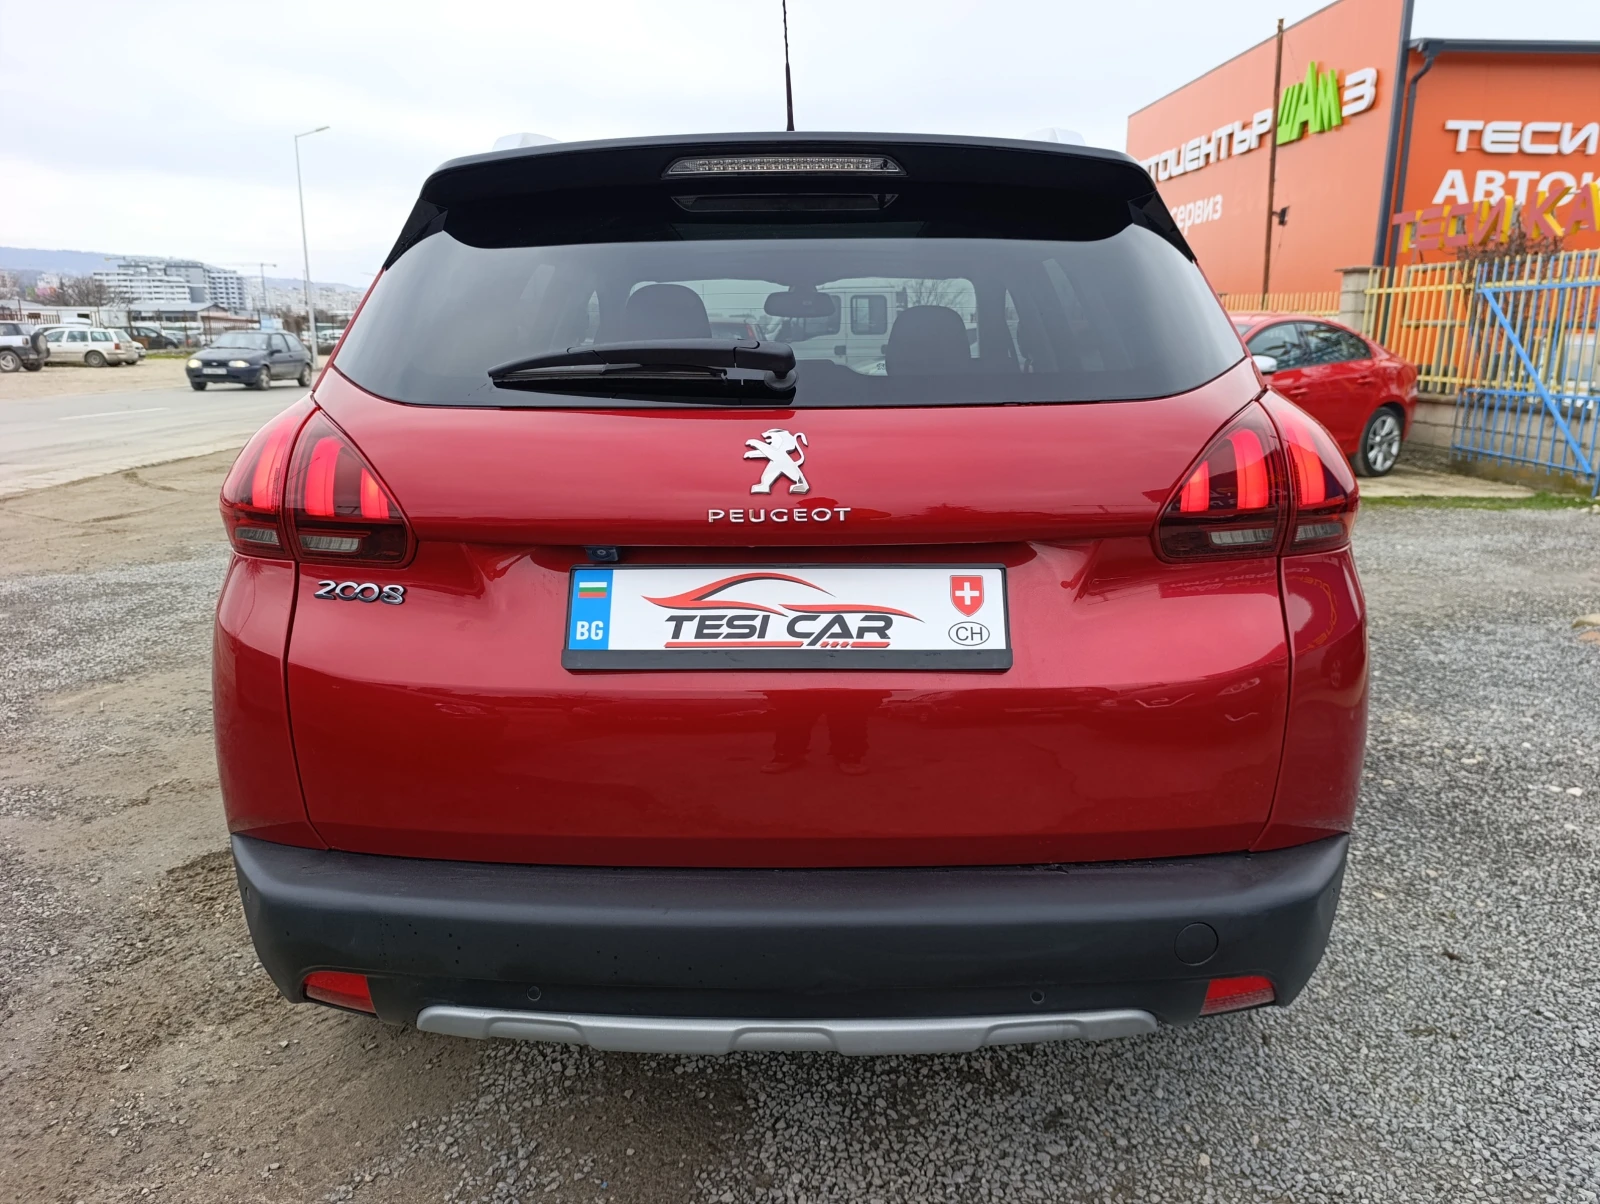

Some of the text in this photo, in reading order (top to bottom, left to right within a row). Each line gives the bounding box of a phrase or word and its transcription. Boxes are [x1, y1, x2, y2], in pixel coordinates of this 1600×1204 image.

[1138, 107, 1273, 182] ТОЦЕНТЪР
[1445, 119, 1600, 154] ТЕСИ
[1391, 195, 1514, 254] ТЕСИ
[708, 507, 852, 524] PEUGEOT
[314, 579, 407, 606] 2008
[575, 620, 605, 641] BG
[665, 614, 894, 646] TESI CAR
[955, 626, 984, 643] CH
